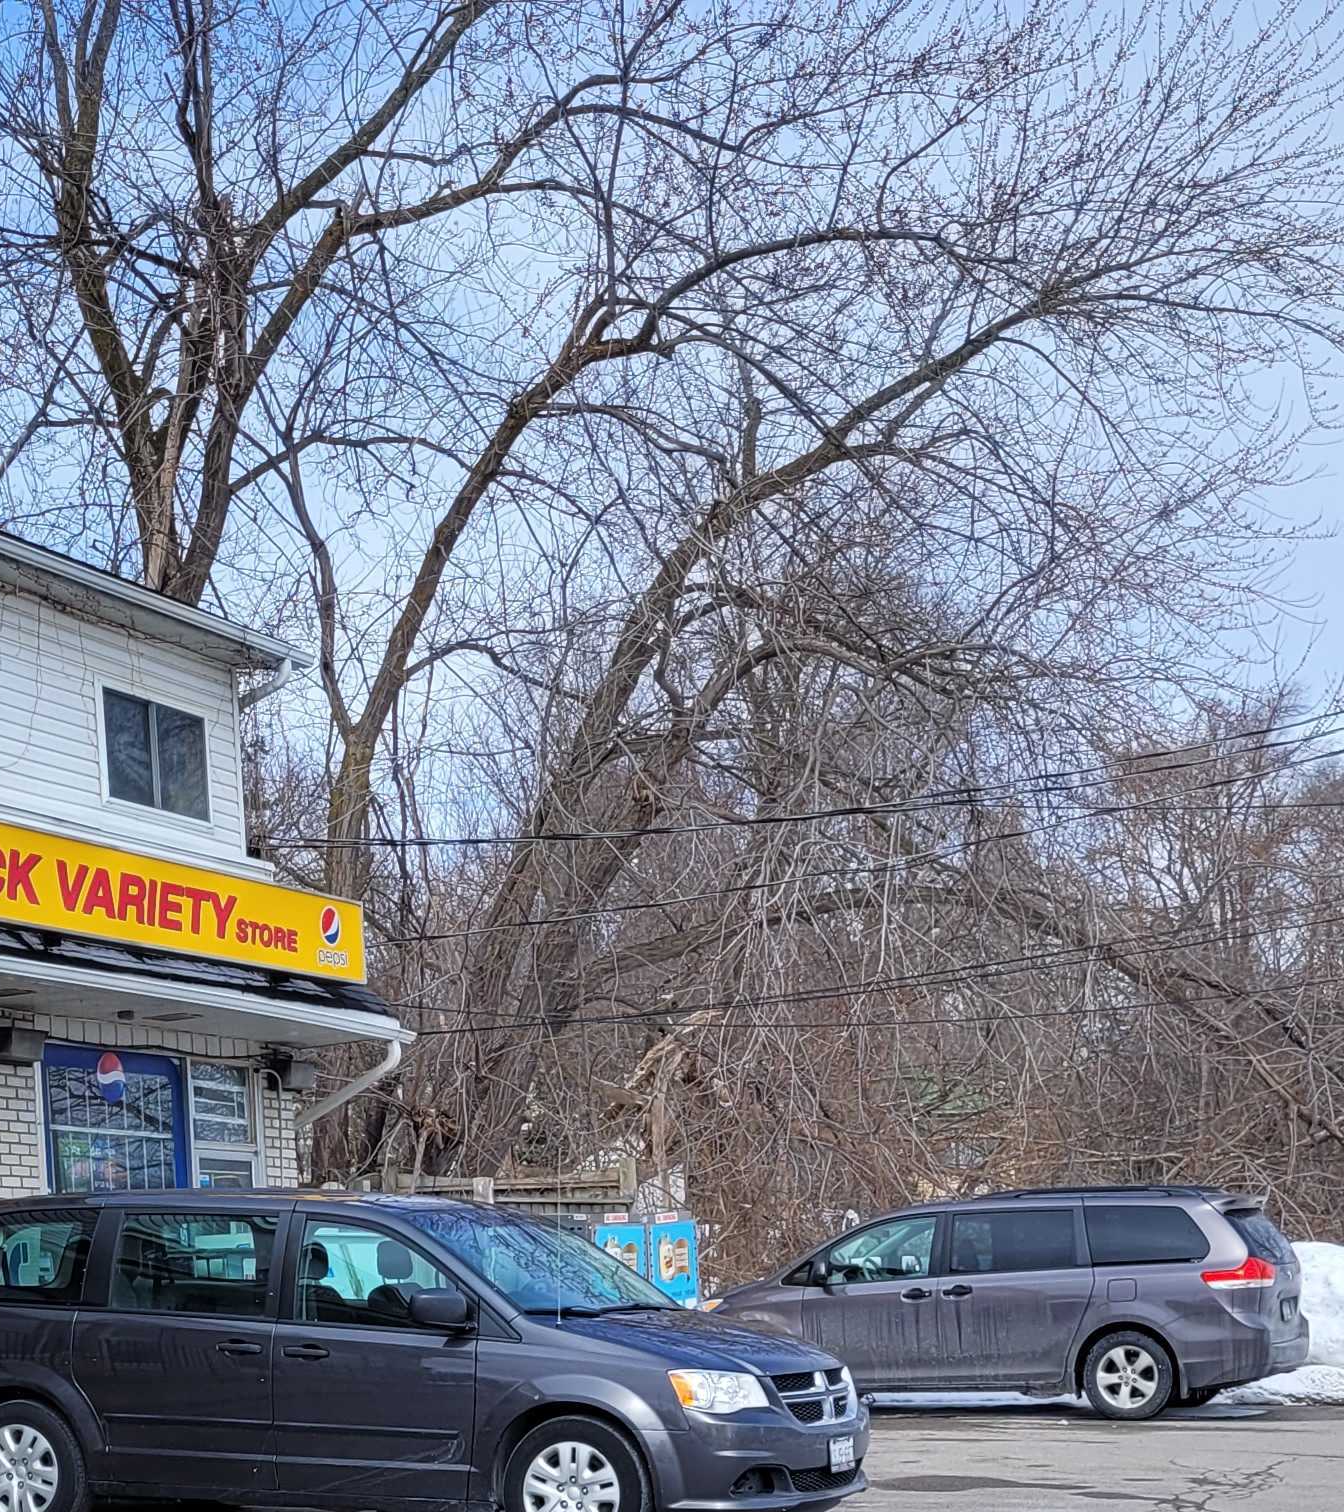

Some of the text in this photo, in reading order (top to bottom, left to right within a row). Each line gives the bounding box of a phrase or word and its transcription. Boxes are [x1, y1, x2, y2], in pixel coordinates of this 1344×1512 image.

[56, 859, 237, 940] VARIETY
[235, 918, 298, 953] STORE
[318, 949, 348, 969] pepsi
